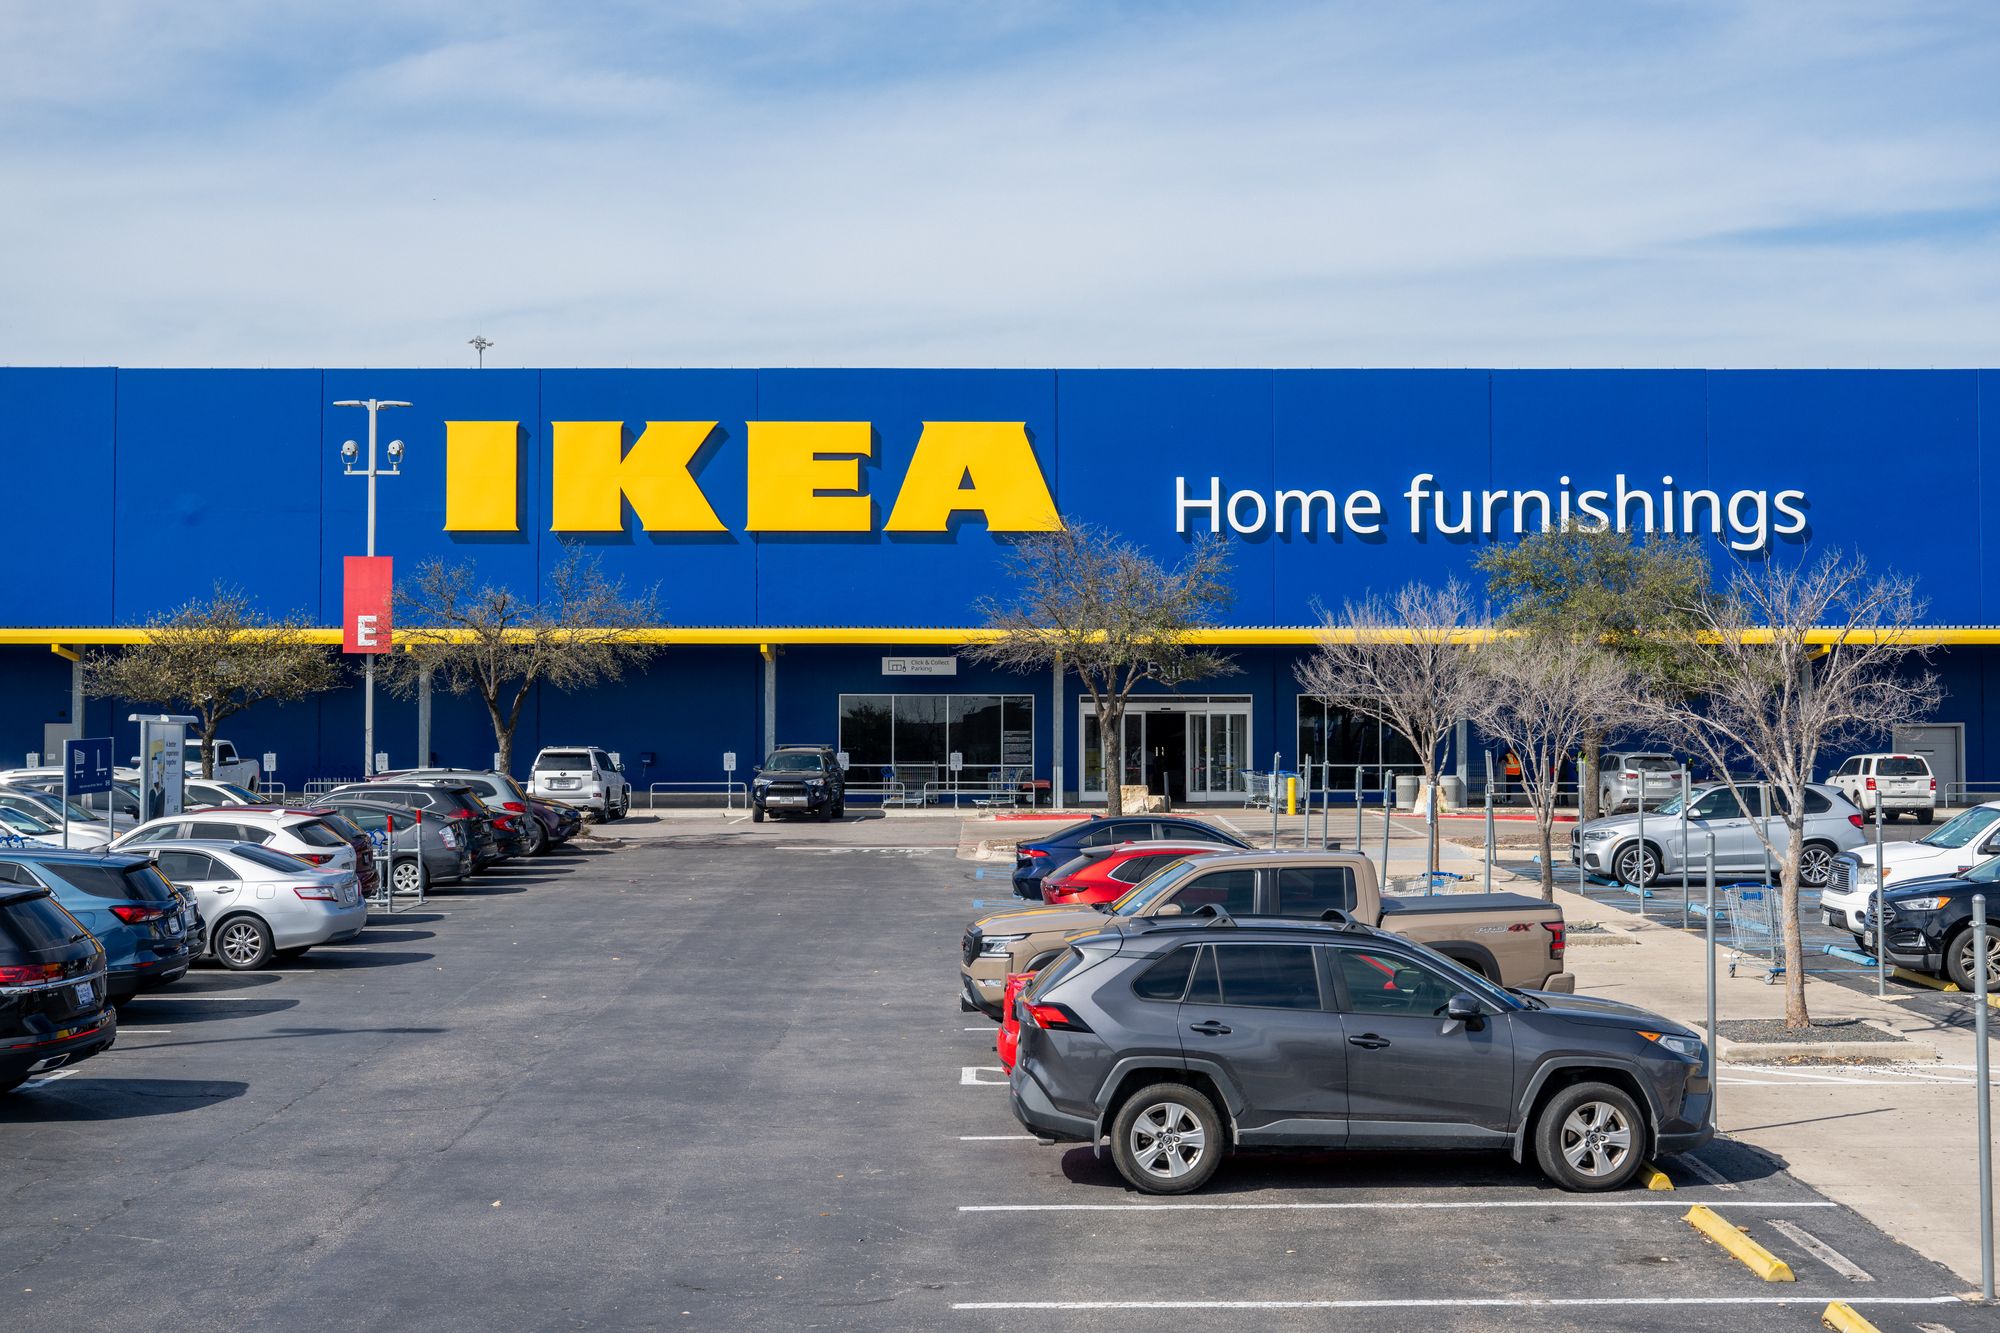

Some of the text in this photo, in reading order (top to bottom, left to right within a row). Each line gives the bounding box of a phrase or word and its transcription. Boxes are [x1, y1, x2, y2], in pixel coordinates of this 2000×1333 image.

[444, 420, 1067, 532] IKEA
[1175, 473, 1806, 552] Home furnishings
[357, 615, 378, 647] E
